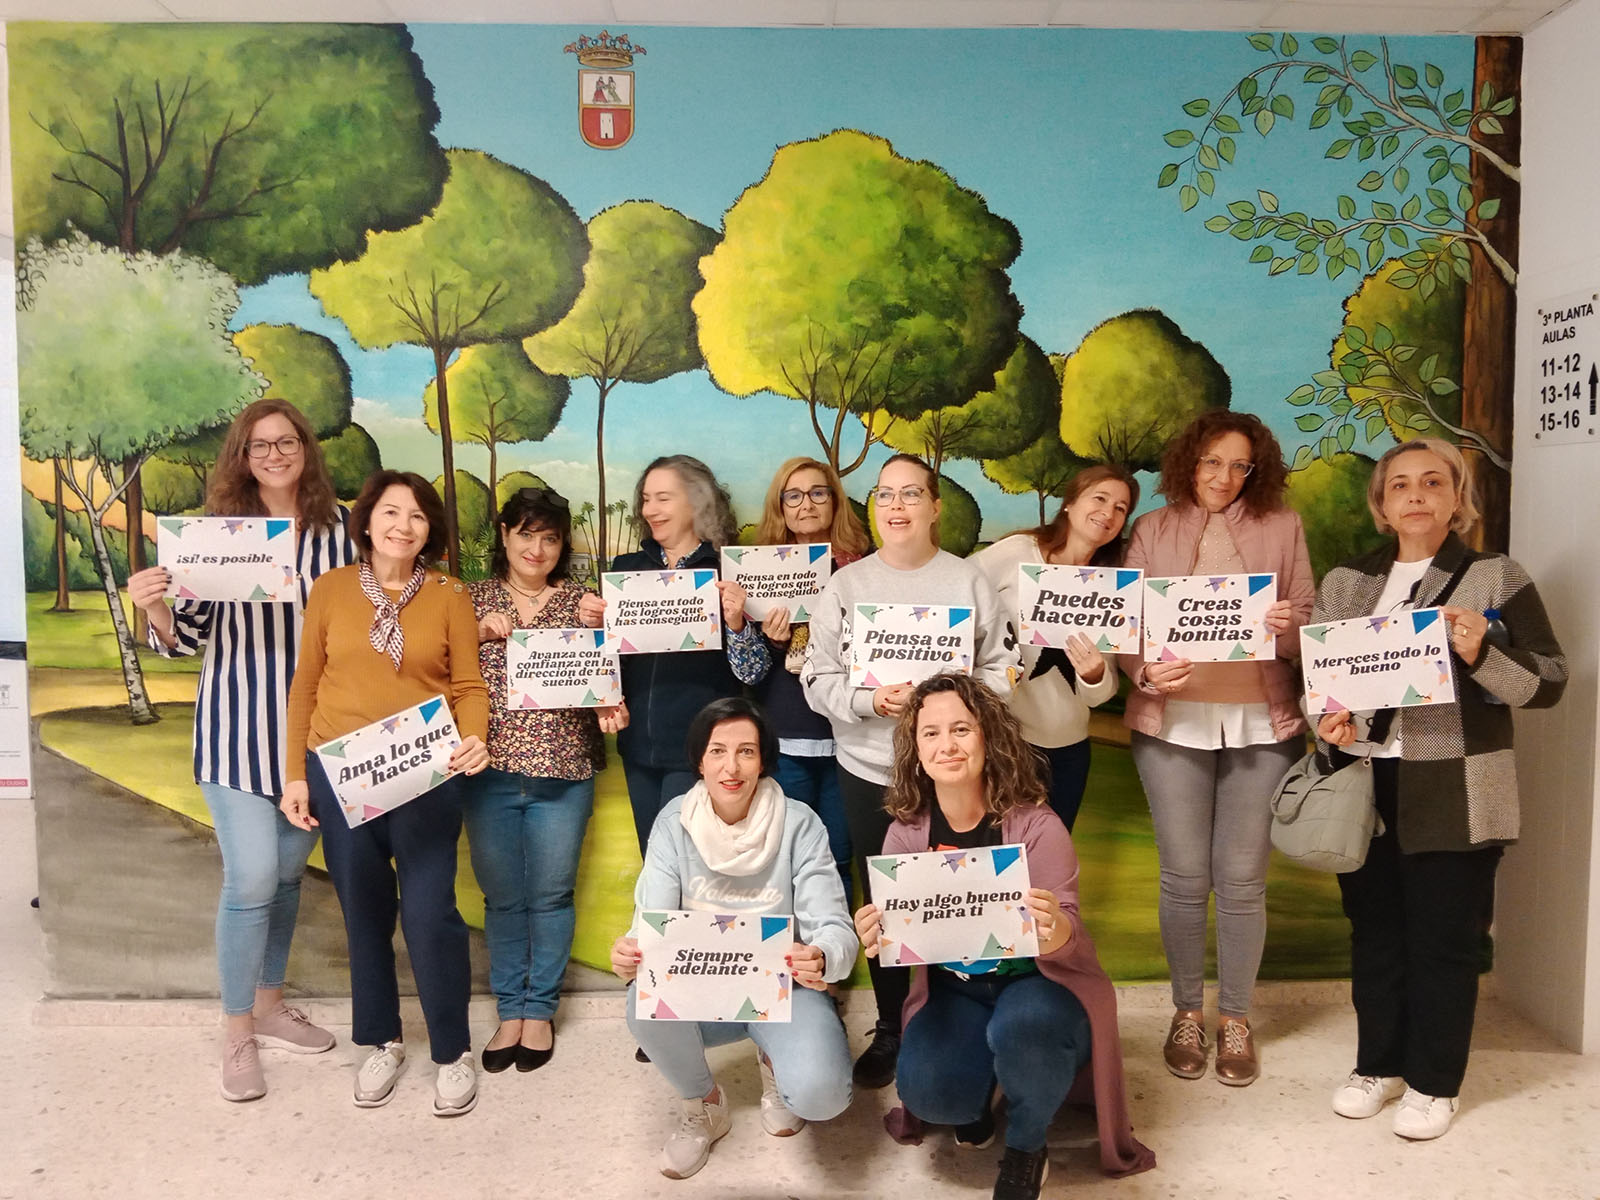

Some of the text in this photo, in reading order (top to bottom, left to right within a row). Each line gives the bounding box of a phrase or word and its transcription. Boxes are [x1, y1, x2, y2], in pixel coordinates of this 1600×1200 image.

[1554, 303, 1594, 323] PLANTA
[1542, 326, 1576, 344] AULAS
[1541, 353, 1581, 377] 11-12
[1541, 381, 1581, 404] 13-14
[1540, 410, 1580, 431] 15-16
[219, 554, 273, 565] posible
[736, 573, 774, 581] Piensa
[792, 571, 817, 579] todo
[756, 587, 819, 598] conseguido
[757, 581, 794, 591] logros
[796, 580, 816, 589] que
[618, 599, 658, 608] Piensa
[677, 597, 704, 605] todo
[1036, 590, 1125, 610] Puedes
[1178, 598, 1242, 612] Creas
[615, 614, 707, 626] has conseguido
[620, 607, 703, 618] los logros que
[1031, 605, 1125, 627] hacerlo
[1178, 614, 1242, 627] cosas
[864, 629, 962, 647] Piensa en
[1167, 626, 1253, 642] bonitas
[528, 651, 576, 660] Avanza
[868, 646, 954, 662] positivo
[1313, 645, 1441, 669] Mereces todo lo
[517, 659, 581, 670] confianza
[602, 658, 613, 667] la
[1350, 662, 1401, 675] bueno
[516, 668, 575, 679] dirección
[579, 668, 593, 676] de
[542, 677, 588, 687] sueños
[338, 724, 452, 785] Ama lo que
[371, 749, 432, 787] haces
[689, 876, 784, 902] Valencia
[885, 890, 1022, 911] Hay algo bueno
[922, 903, 984, 923] para ti
[675, 948, 754, 964] Siempre
[668, 963, 748, 975] adelante
